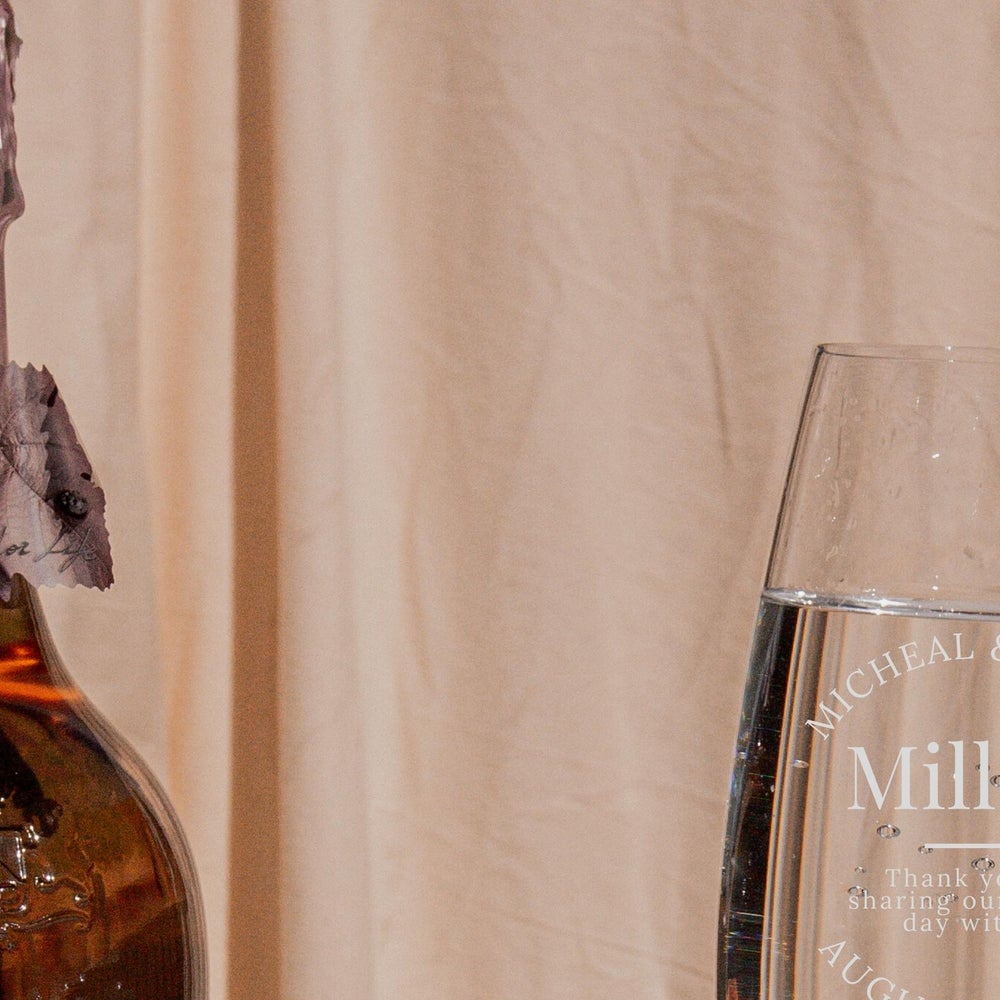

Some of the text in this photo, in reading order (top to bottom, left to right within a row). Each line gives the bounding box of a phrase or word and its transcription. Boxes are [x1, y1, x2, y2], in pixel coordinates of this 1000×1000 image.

[805, 633, 974, 740] MICHEAL
[885, 868, 968, 888] Thank
[848, 891, 951, 915] sharing
[903, 913, 950, 938] day
